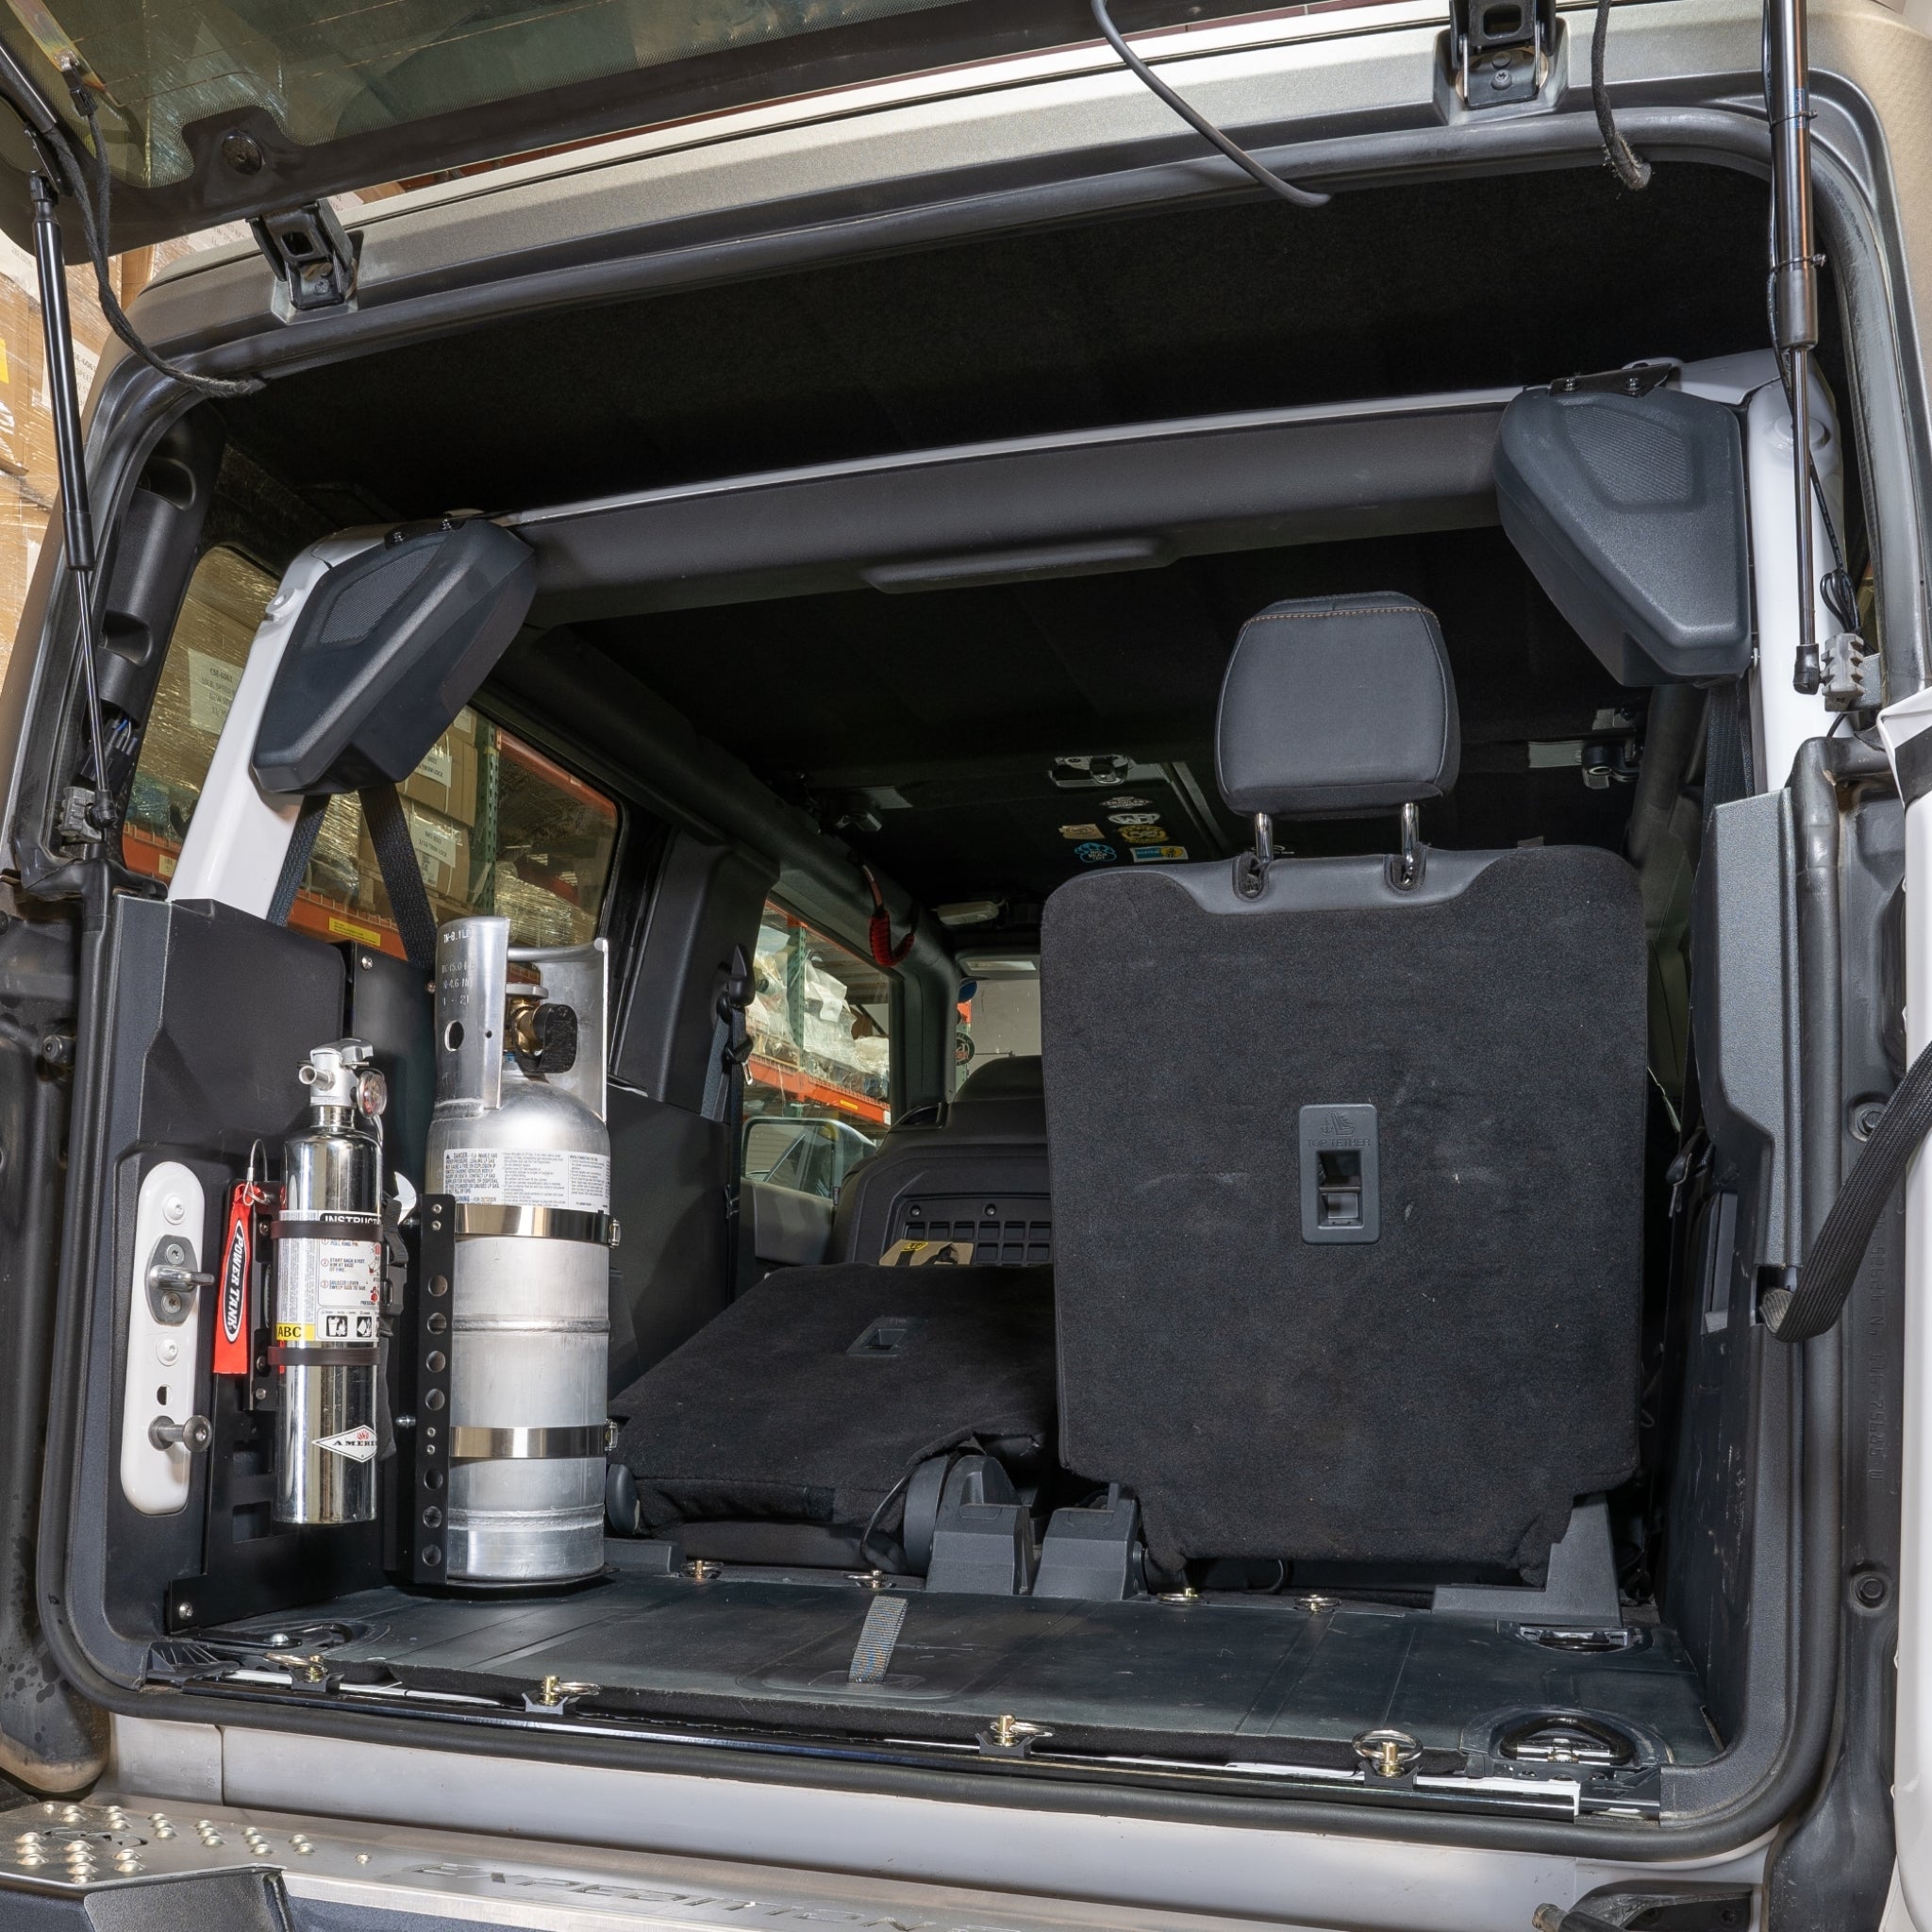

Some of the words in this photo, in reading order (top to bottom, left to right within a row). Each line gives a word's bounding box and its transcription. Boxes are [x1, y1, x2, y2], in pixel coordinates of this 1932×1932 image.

[1306, 1139, 1327, 1148] TOP
[1329, 1138, 1371, 1148] TETHER
[231, 1234, 244, 1286] POWER
[226, 1287, 241, 1330] TANK
[277, 1325, 302, 1338] ABC
